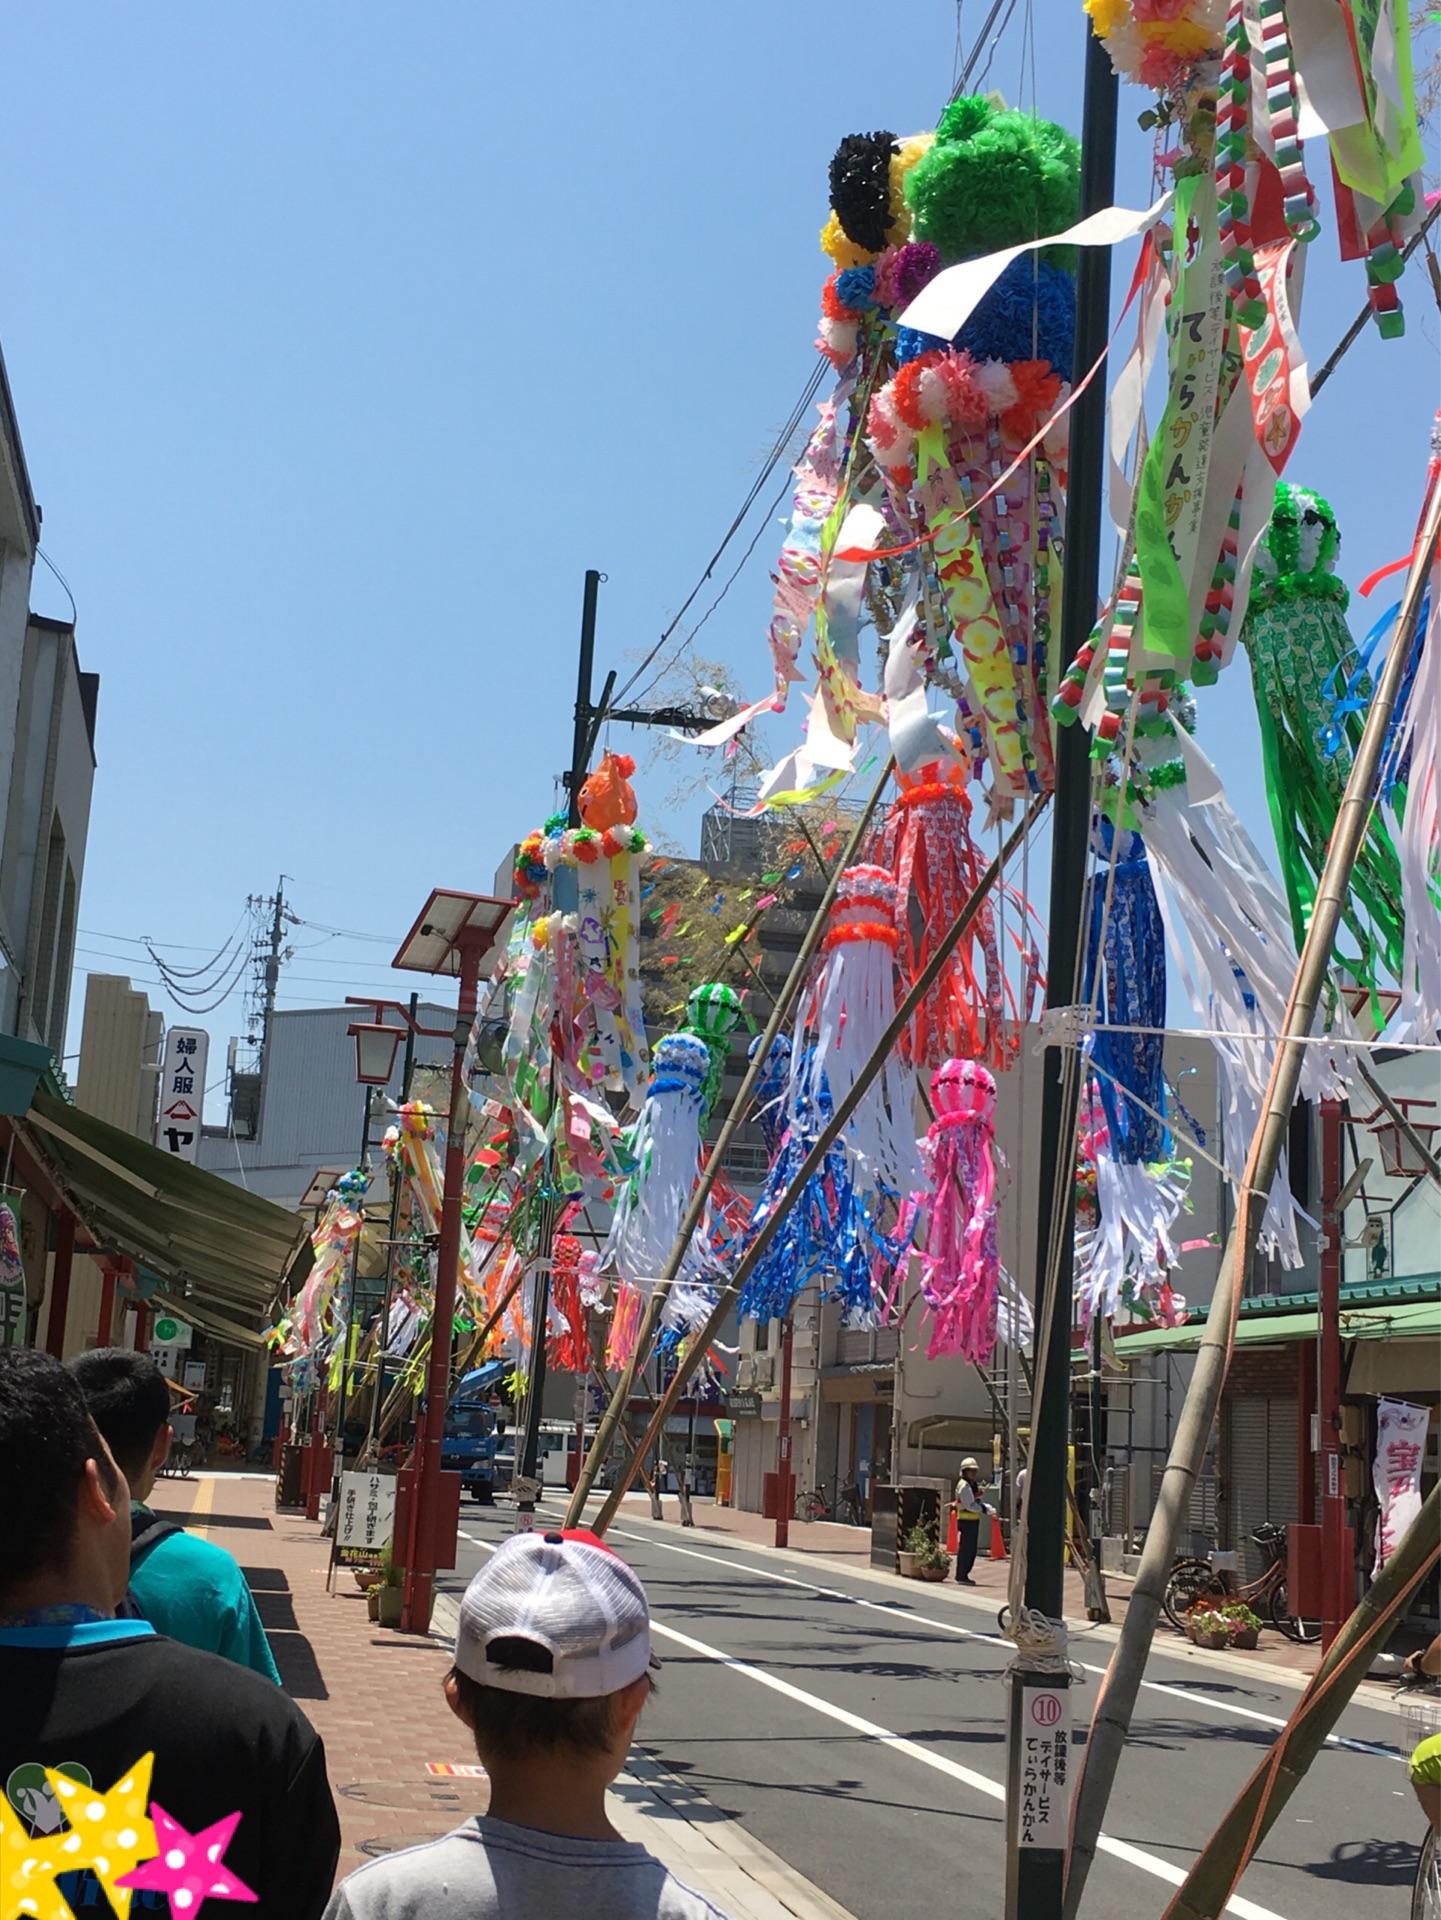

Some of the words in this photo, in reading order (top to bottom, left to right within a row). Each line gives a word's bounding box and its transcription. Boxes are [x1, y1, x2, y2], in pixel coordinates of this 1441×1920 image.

[172, 1037, 197, 1095] 婦人服
[1022, 1737, 1039, 1843] てぃらかんかん
[1038, 1741, 1053, 1824] デイサービス
[1053, 1730, 1068, 1786] 放課後等
